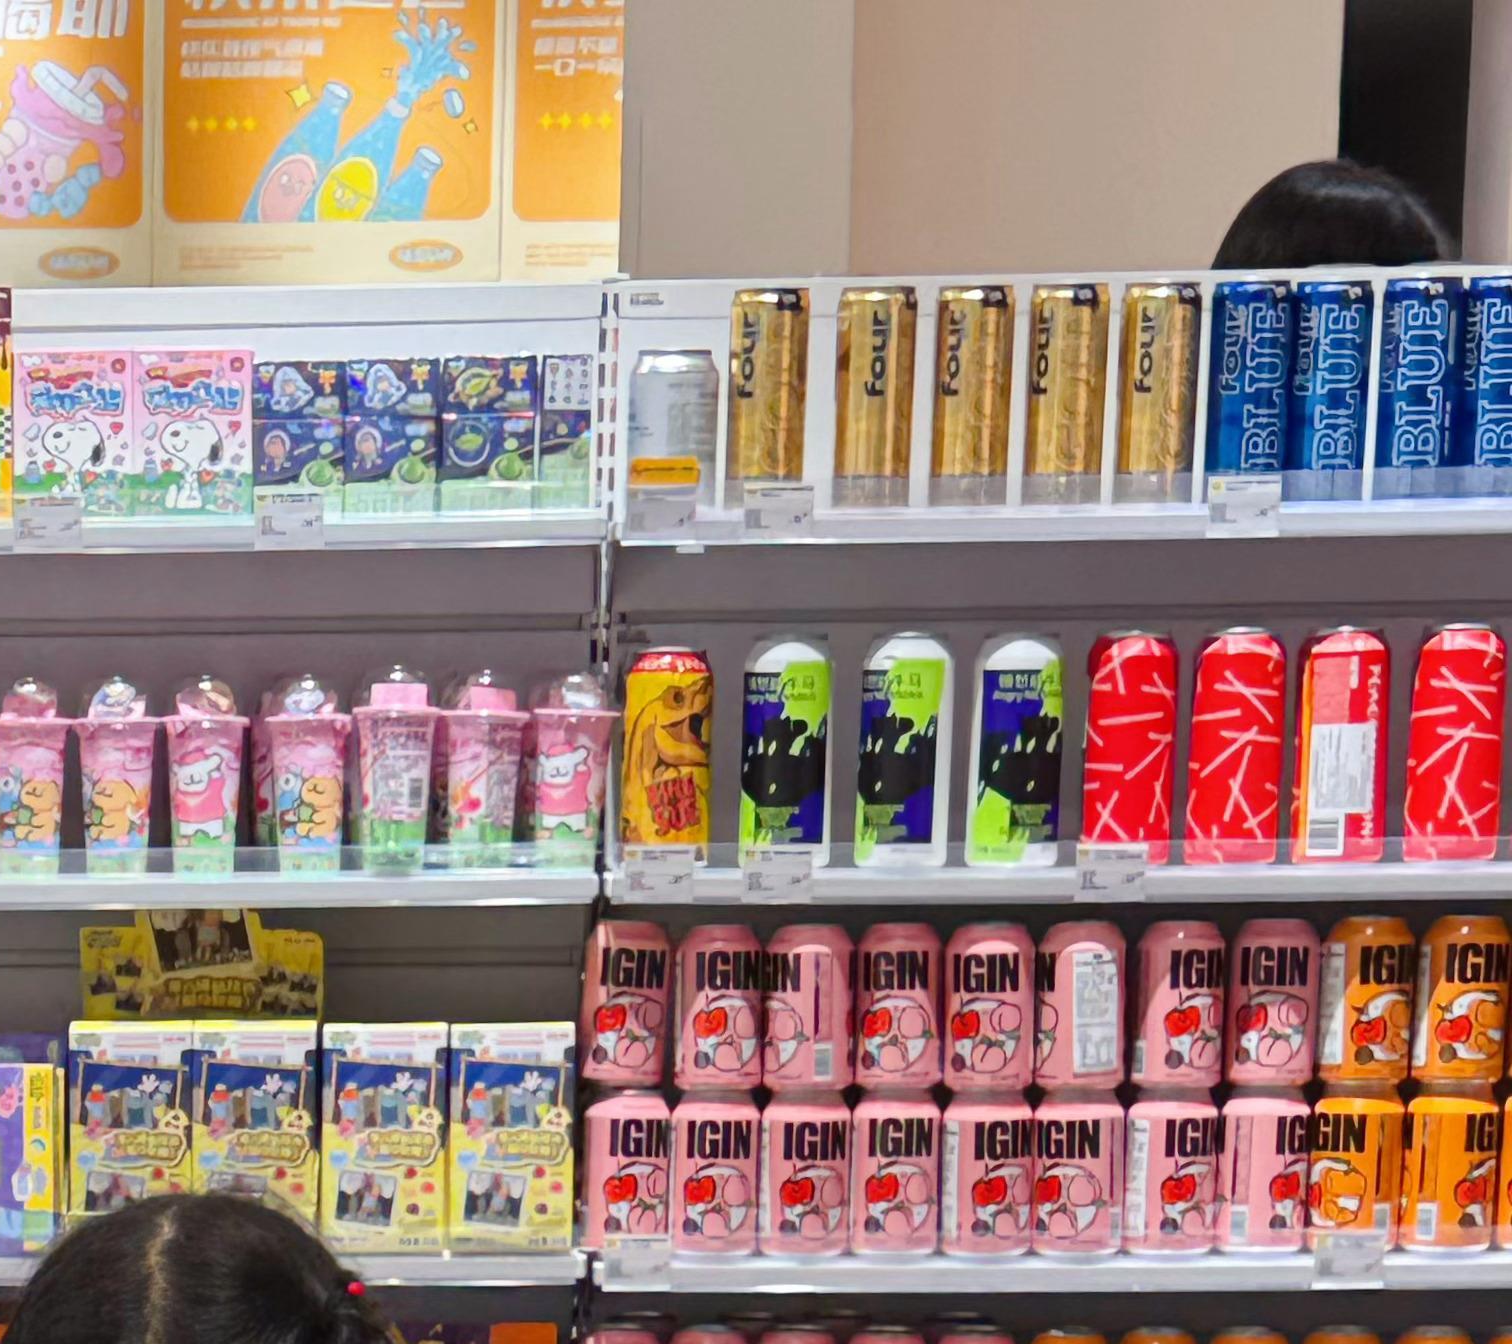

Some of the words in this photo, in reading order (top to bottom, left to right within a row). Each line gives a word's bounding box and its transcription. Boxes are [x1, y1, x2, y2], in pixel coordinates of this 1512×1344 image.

[1241, 302, 1289, 469] BLUE
[1312, 302, 1362, 470] BLUE
[1392, 299, 1448, 467] BLUE
[600, 947, 666, 989] IGIN
[863, 951, 929, 991] IGIN
[953, 952, 1019, 992] IGIN
[1240, 946, 1309, 987] IGIN
[687, 1120, 751, 1159] IGIN
[783, 1121, 846, 1161] IGIN
[868, 1118, 933, 1158] IGIN
